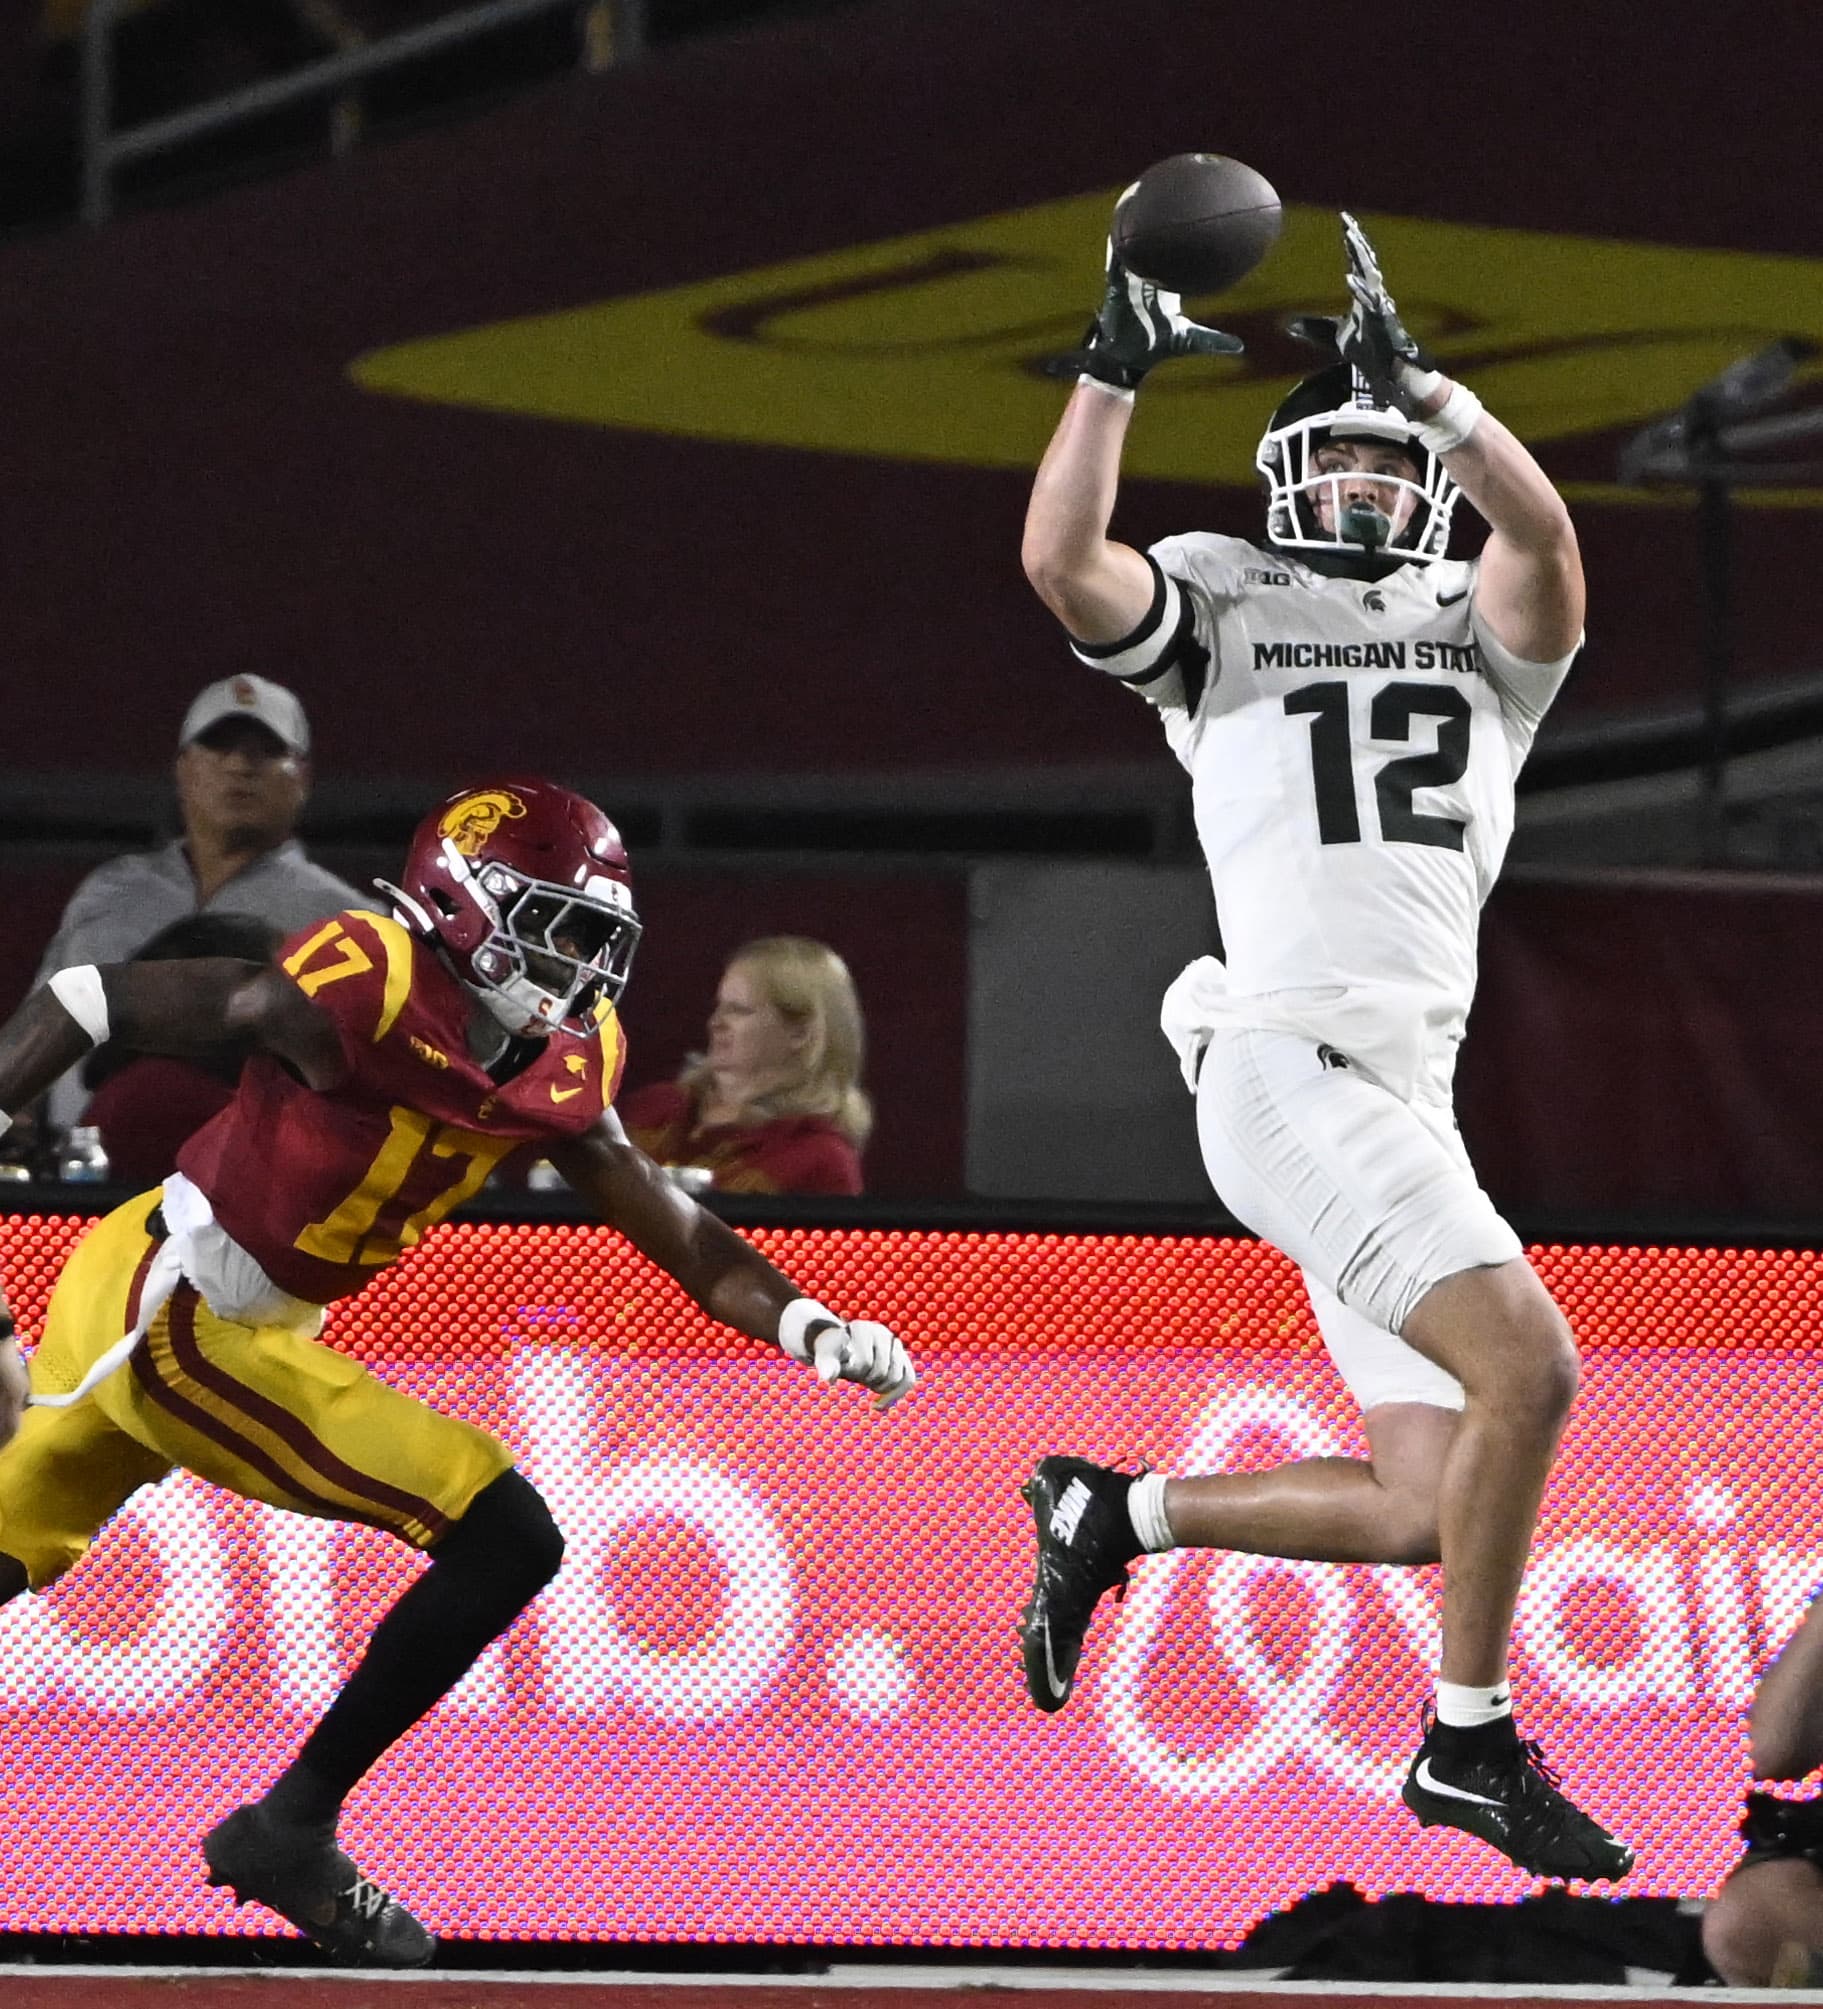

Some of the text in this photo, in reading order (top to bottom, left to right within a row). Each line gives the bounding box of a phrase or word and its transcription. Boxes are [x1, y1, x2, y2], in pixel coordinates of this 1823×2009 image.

[1252, 640, 1483, 673] MICHIGAN STAT
[1283, 681, 1472, 853] 12
[282, 920, 374, 998] 17
[293, 1105, 526, 1266] 17
[1049, 1475, 1093, 1547] NIKE
